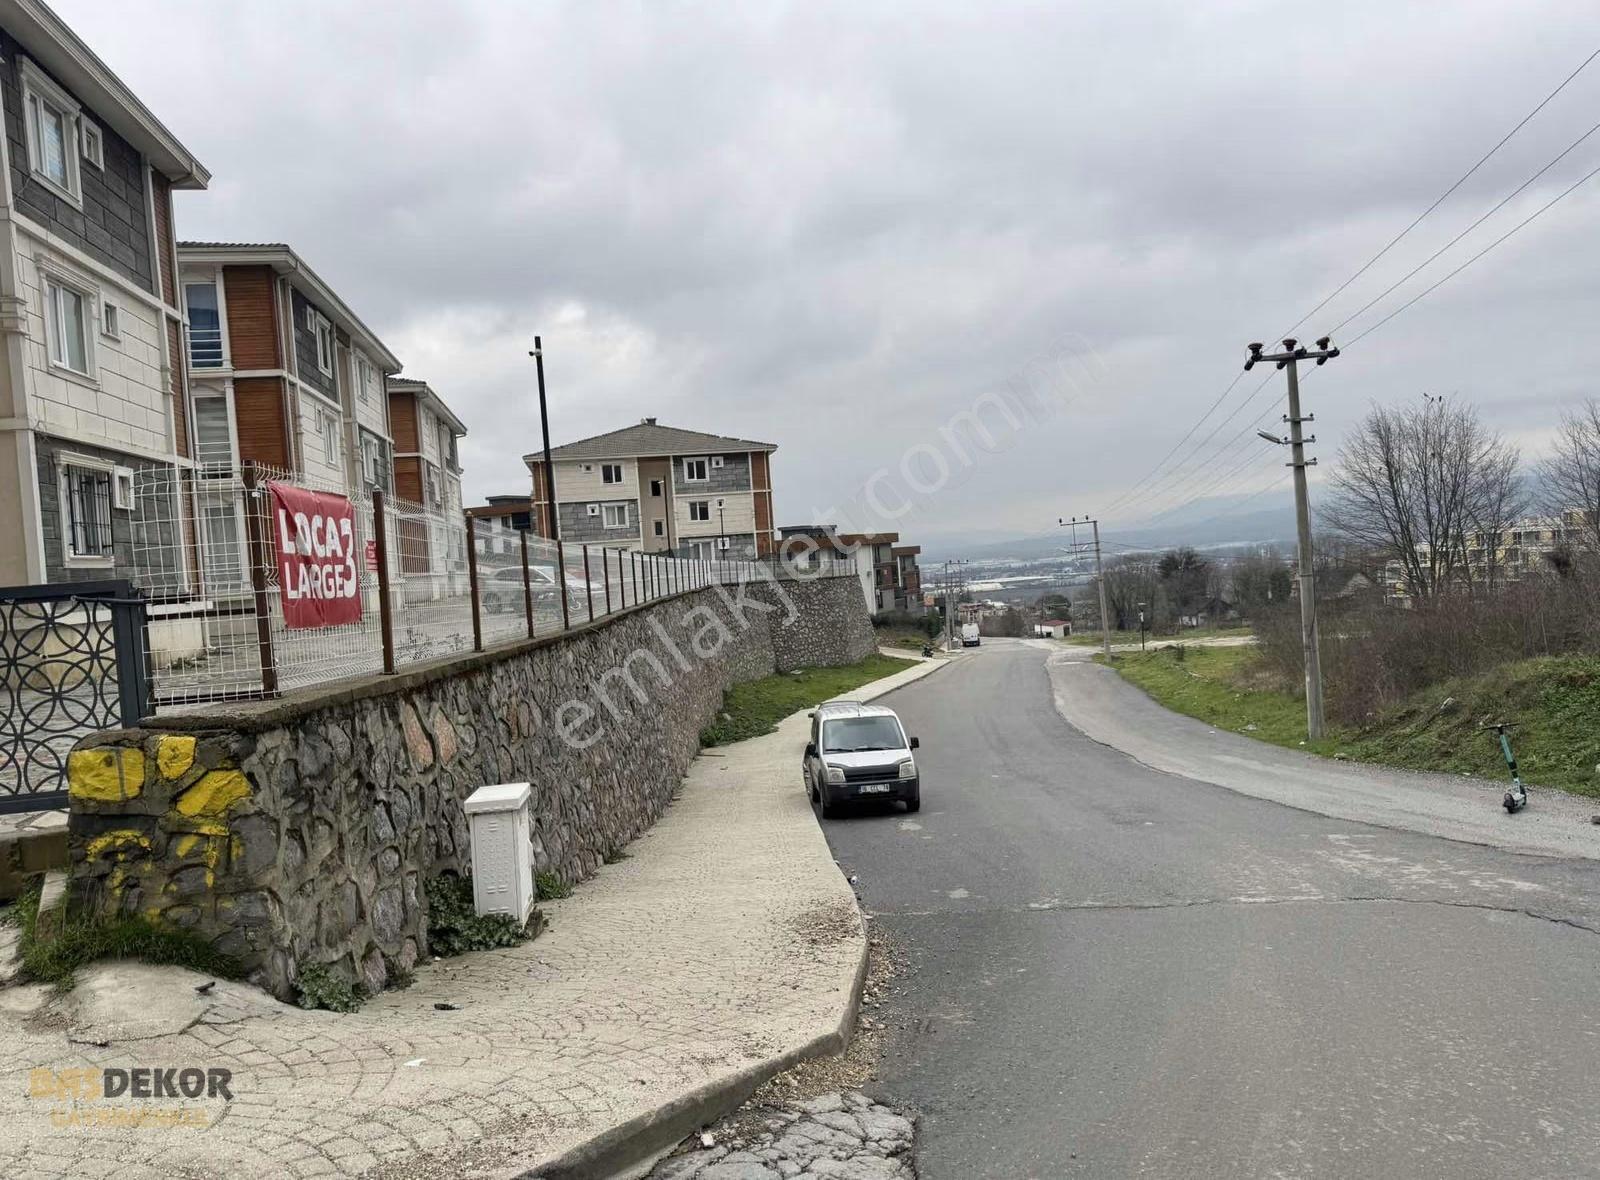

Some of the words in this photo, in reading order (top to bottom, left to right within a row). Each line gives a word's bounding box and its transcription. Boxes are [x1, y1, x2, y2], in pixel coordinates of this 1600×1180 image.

[278, 508, 343, 558] LOCA
[340, 517, 357, 598] 3
[284, 562, 344, 599] LARGE
